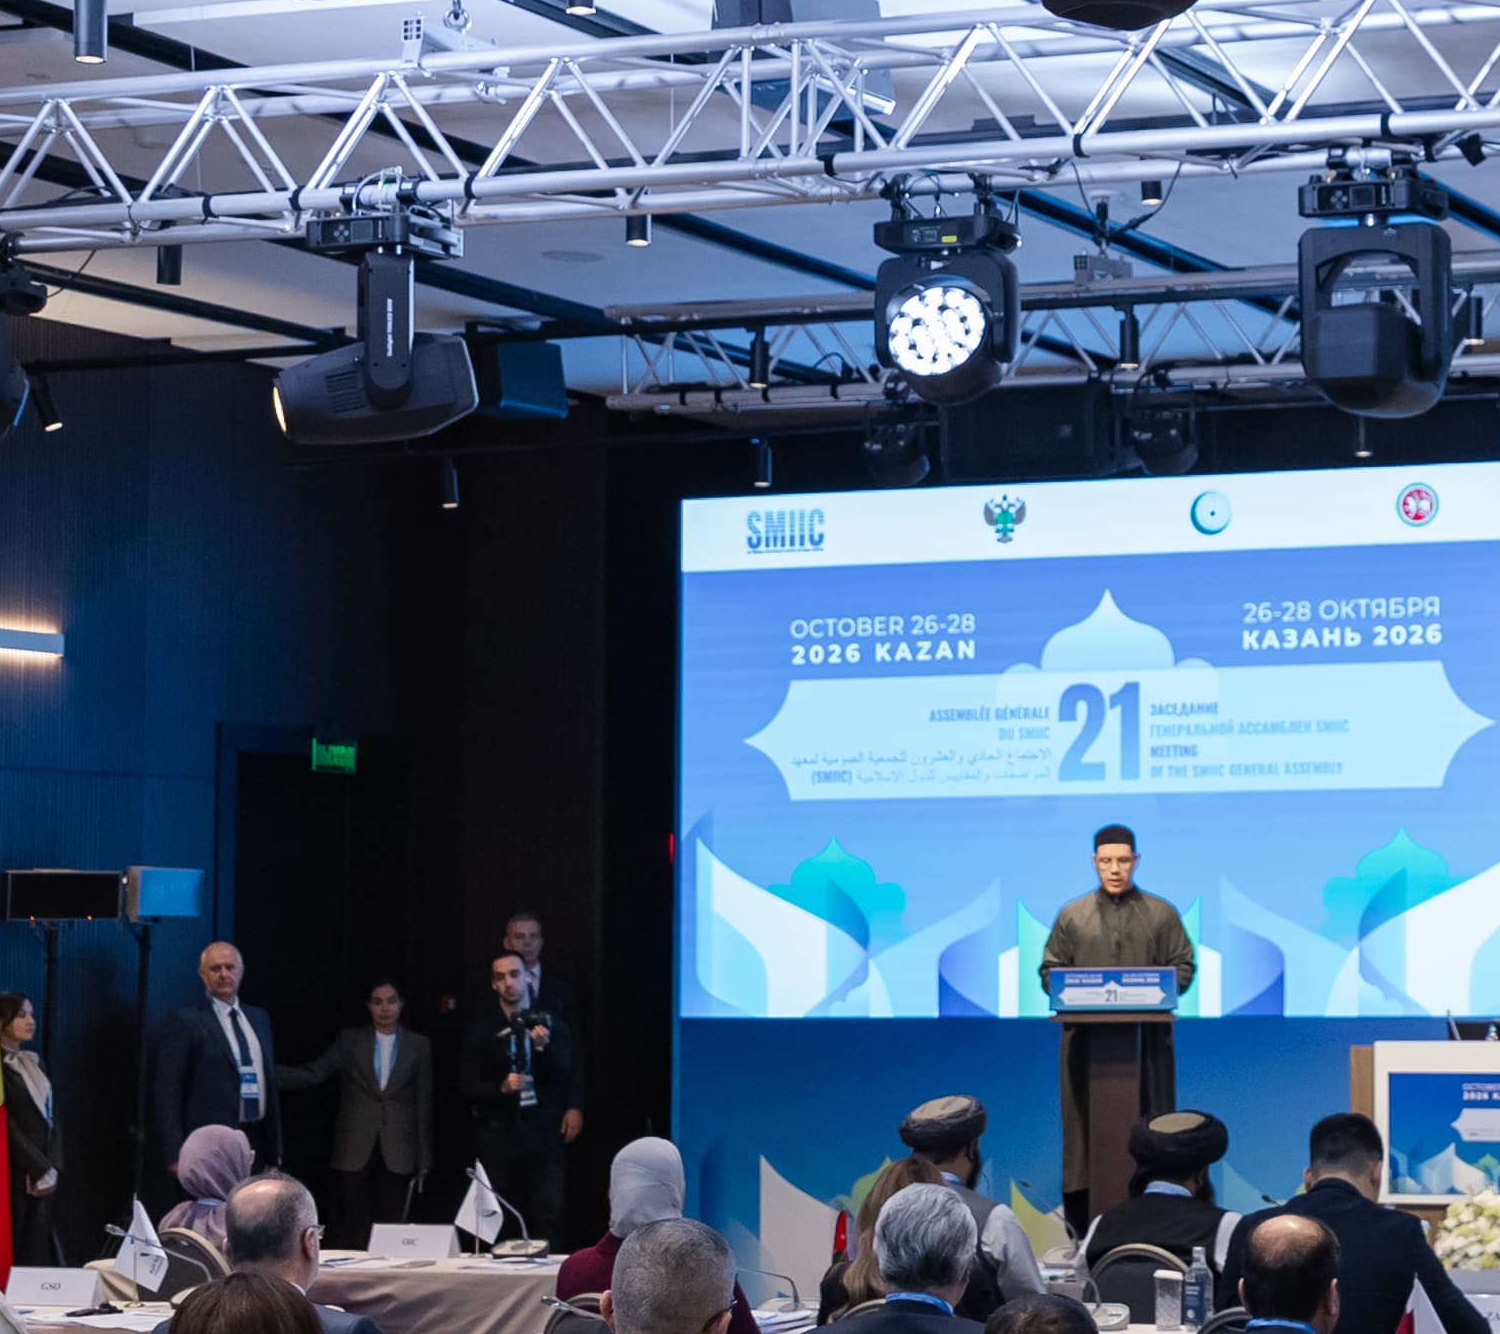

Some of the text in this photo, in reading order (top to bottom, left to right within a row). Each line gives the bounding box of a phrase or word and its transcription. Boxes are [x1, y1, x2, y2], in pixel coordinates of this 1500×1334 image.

[746, 508, 825, 550] SMIIC
[1243, 596, 1441, 624] 26-28 ОКТЯБРЯ
[790, 613, 976, 640] OCTOBER 26-28
[1243, 623, 1443, 651] КАЗАНЬ 2026
[791, 639, 976, 665] 2026 KAZAN
[1058, 682, 1141, 782] 21
